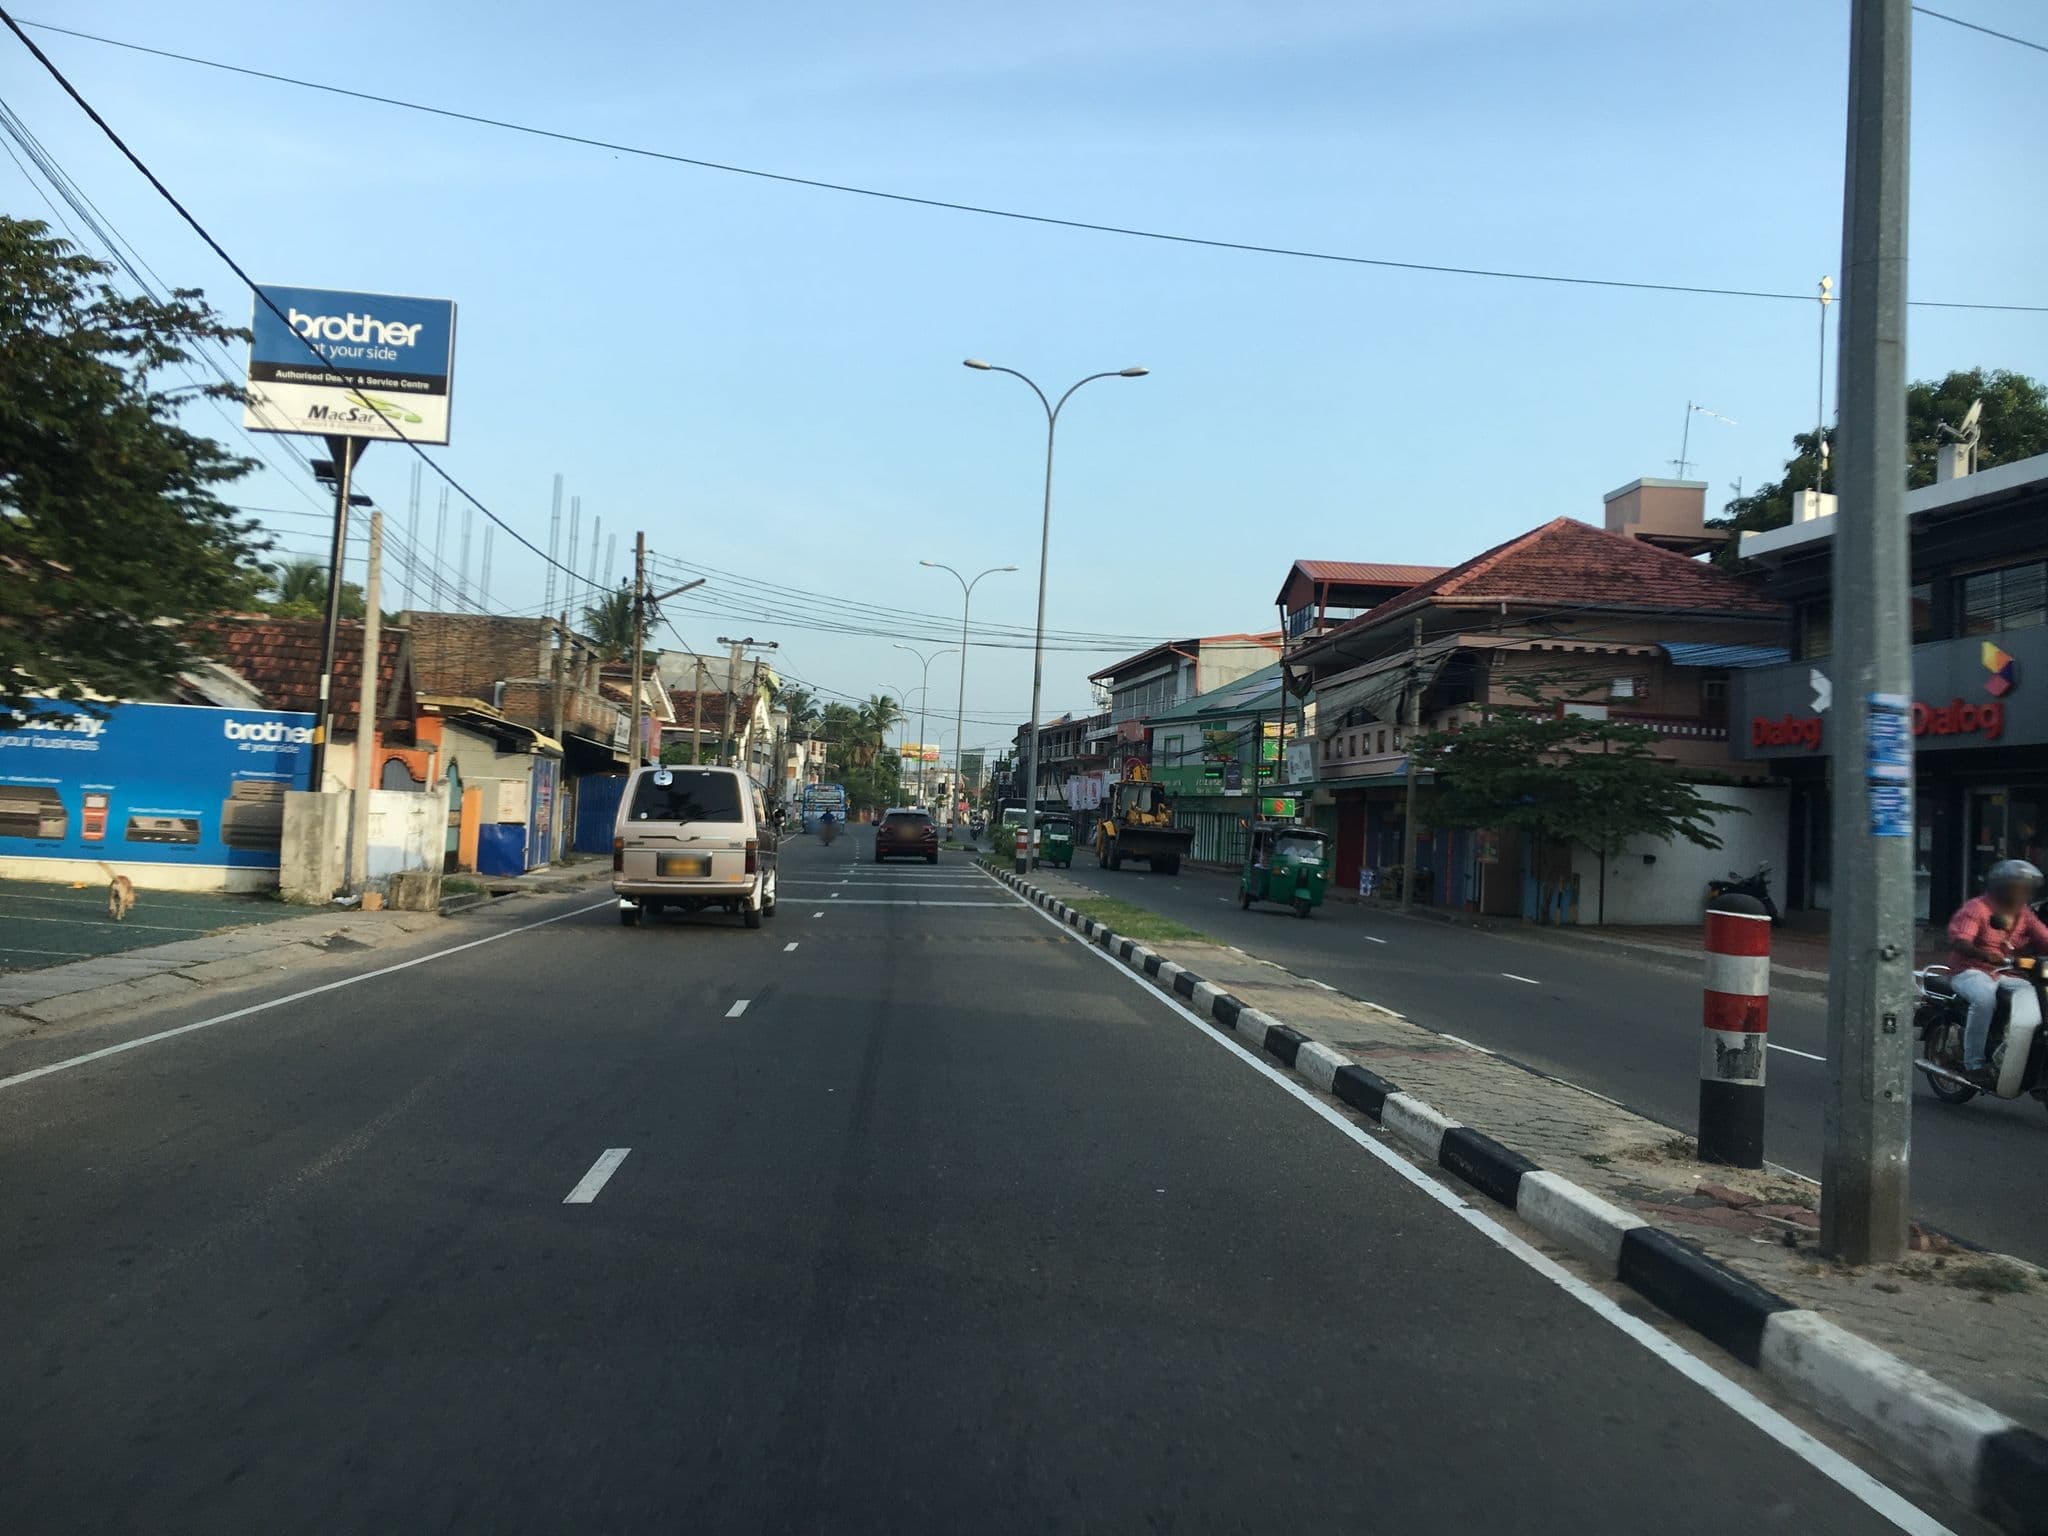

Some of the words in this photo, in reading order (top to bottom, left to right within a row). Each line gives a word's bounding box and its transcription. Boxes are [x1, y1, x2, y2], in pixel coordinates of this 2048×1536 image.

[288, 308, 422, 346] brother
[329, 345, 365, 359] your
[366, 346, 397, 361] side
[275, 369, 323, 382] Authorised
[357, 375, 364, 385] &
[366, 376, 399, 388] Service
[401, 379, 429, 390] Centre
[307, 404, 375, 423] MacSar
[1910, 697, 2004, 740] Dialog
[224, 719, 315, 743] brother
[1751, 713, 1823, 750] Dialog
